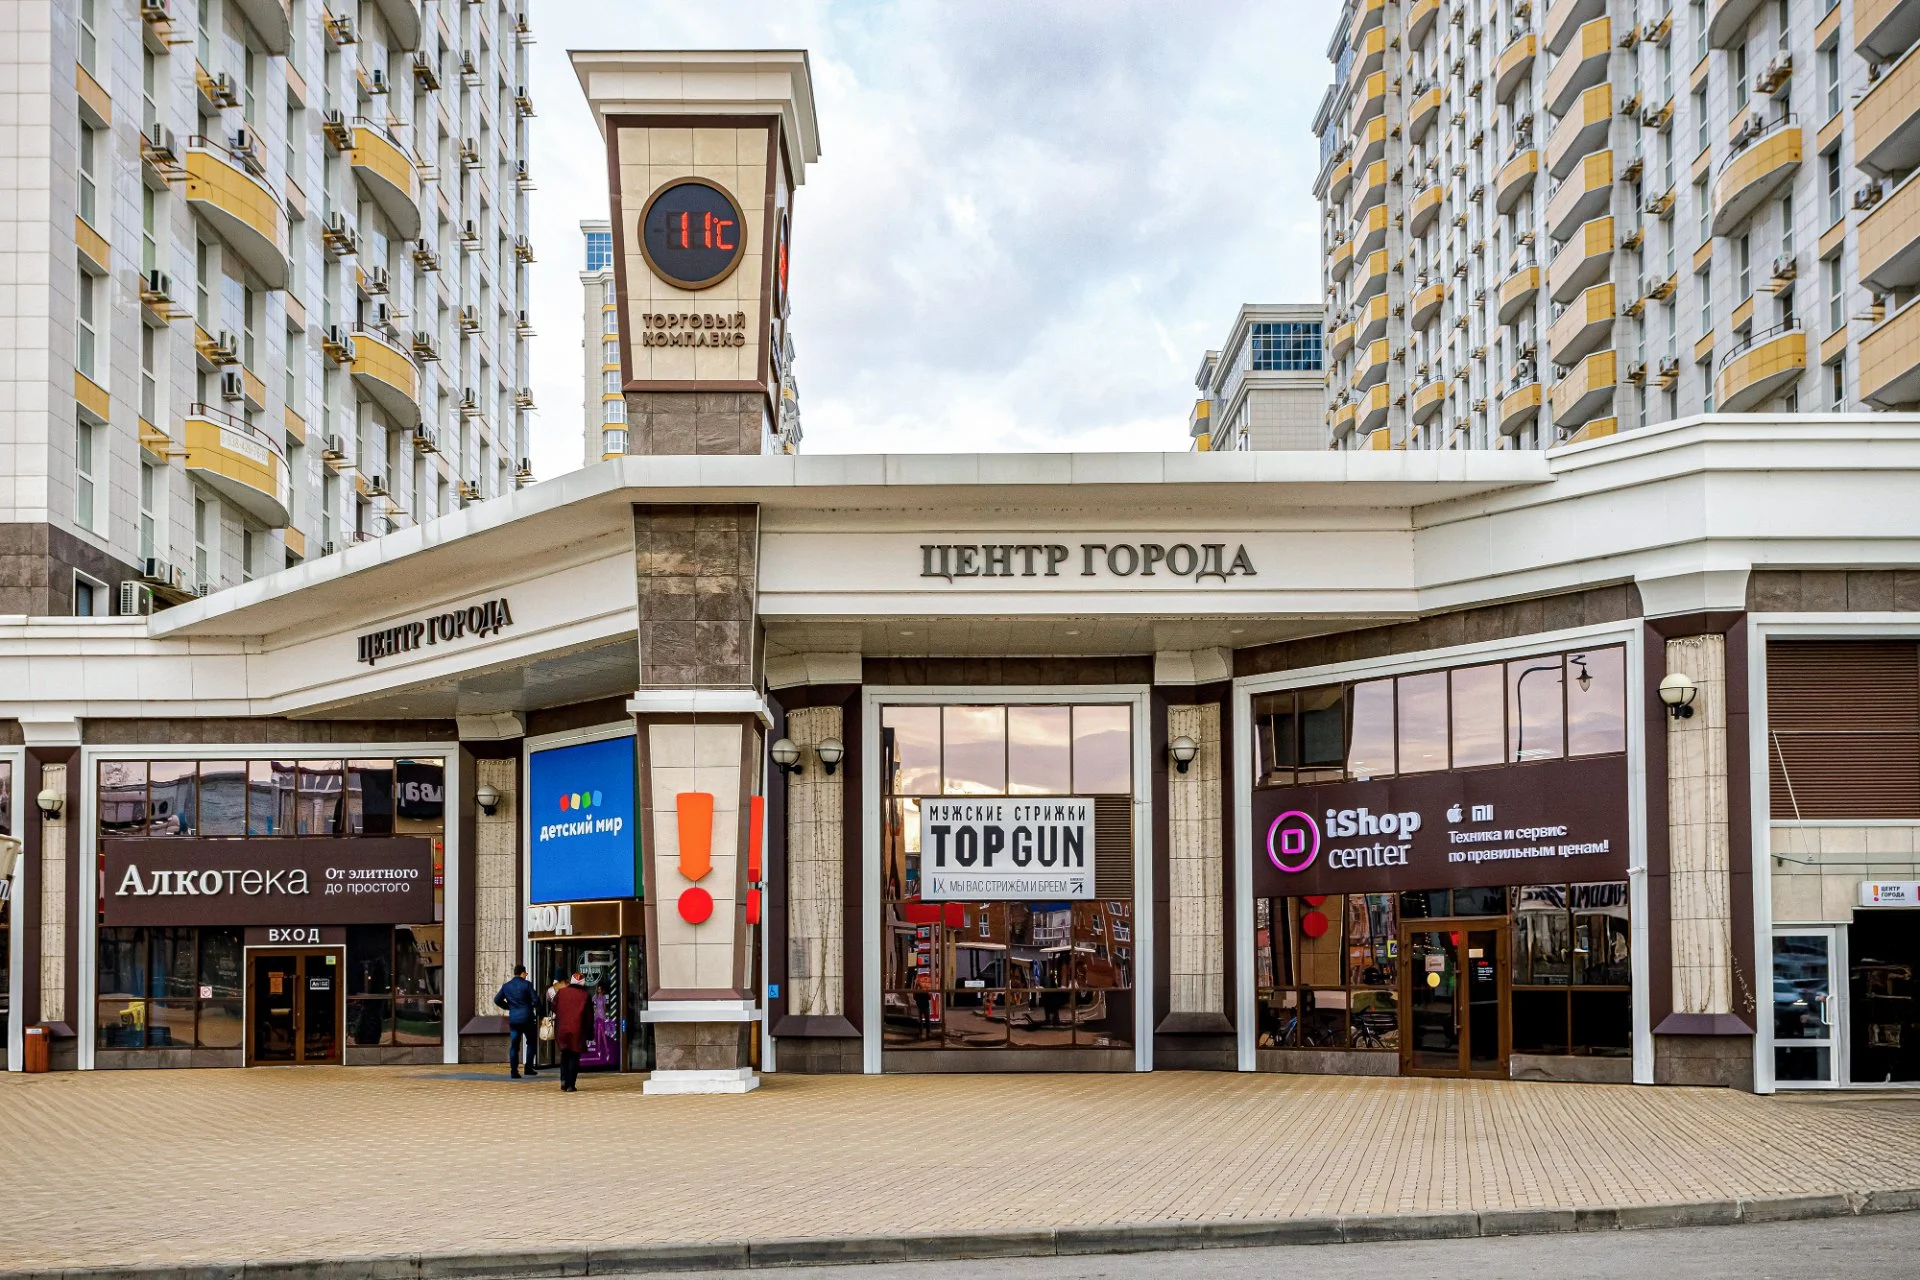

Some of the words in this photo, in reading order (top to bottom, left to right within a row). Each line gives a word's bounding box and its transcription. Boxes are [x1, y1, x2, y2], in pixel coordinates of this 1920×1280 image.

[642, 311, 746, 329] ТОРГОВЫЙ
[642, 332, 746, 348] КОМПЛЕКС
[920, 544, 1069, 584] ЦЕНТР
[1080, 543, 1258, 583] ГОРОДА
[357, 621, 425, 666] ЦЕНТР
[425, 597, 514, 646] ГОРОДА
[930, 805, 1003, 821] МУЖСКИЕ
[1014, 805, 1086, 821] СТРИЖКИ
[540, 813, 593, 842] детский
[595, 816, 623, 836] мир
[1325, 807, 1421, 841] iShop
[1448, 830, 1503, 844] Техника
[1504, 829, 1515, 840] и
[1516, 824, 1568, 841] сервис
[1328, 842, 1412, 869] center
[1448, 851, 1467, 863] по
[1467, 845, 1556, 864] правильным
[1558, 839, 1610, 858] ценам!
[115, 864, 310, 896] Алкотека
[325, 867, 346, 880] От
[348, 867, 419, 880] элитного
[325, 882, 343, 896] до
[346, 882, 411, 895] простого
[950, 880, 965, 893] МЫ
[966, 880, 984, 893] ВАС
[1030, 880, 1037, 893] И
[1038, 880, 1068, 893] БРЕЕМ
[268, 928, 320, 944] ВХОД
